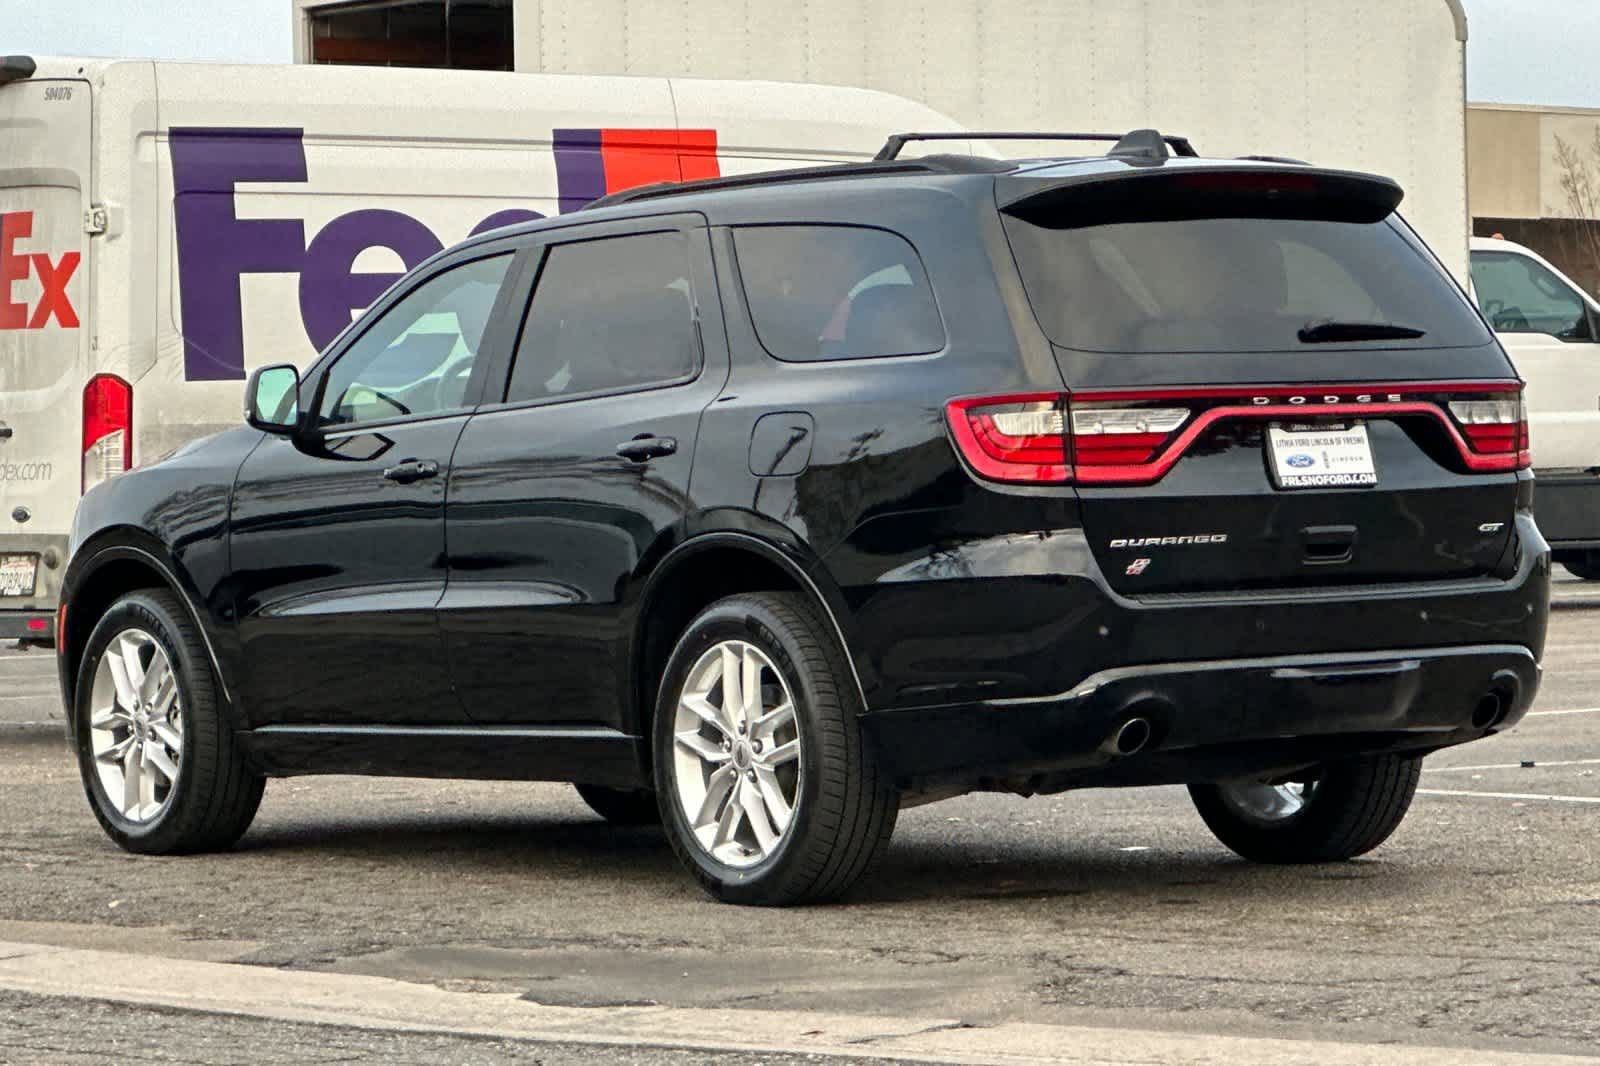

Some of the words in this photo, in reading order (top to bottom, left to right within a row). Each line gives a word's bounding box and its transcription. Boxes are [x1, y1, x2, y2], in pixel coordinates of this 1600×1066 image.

[1252, 393, 1401, 405] DODGE
[1296, 438, 1311, 447] FORD
[1311, 437, 1334, 446] LINCOLN
[1343, 436, 1365, 444] FRESNO
[1478, 523, 1504, 531] GT
[1109, 534, 1228, 548] DURANGO
